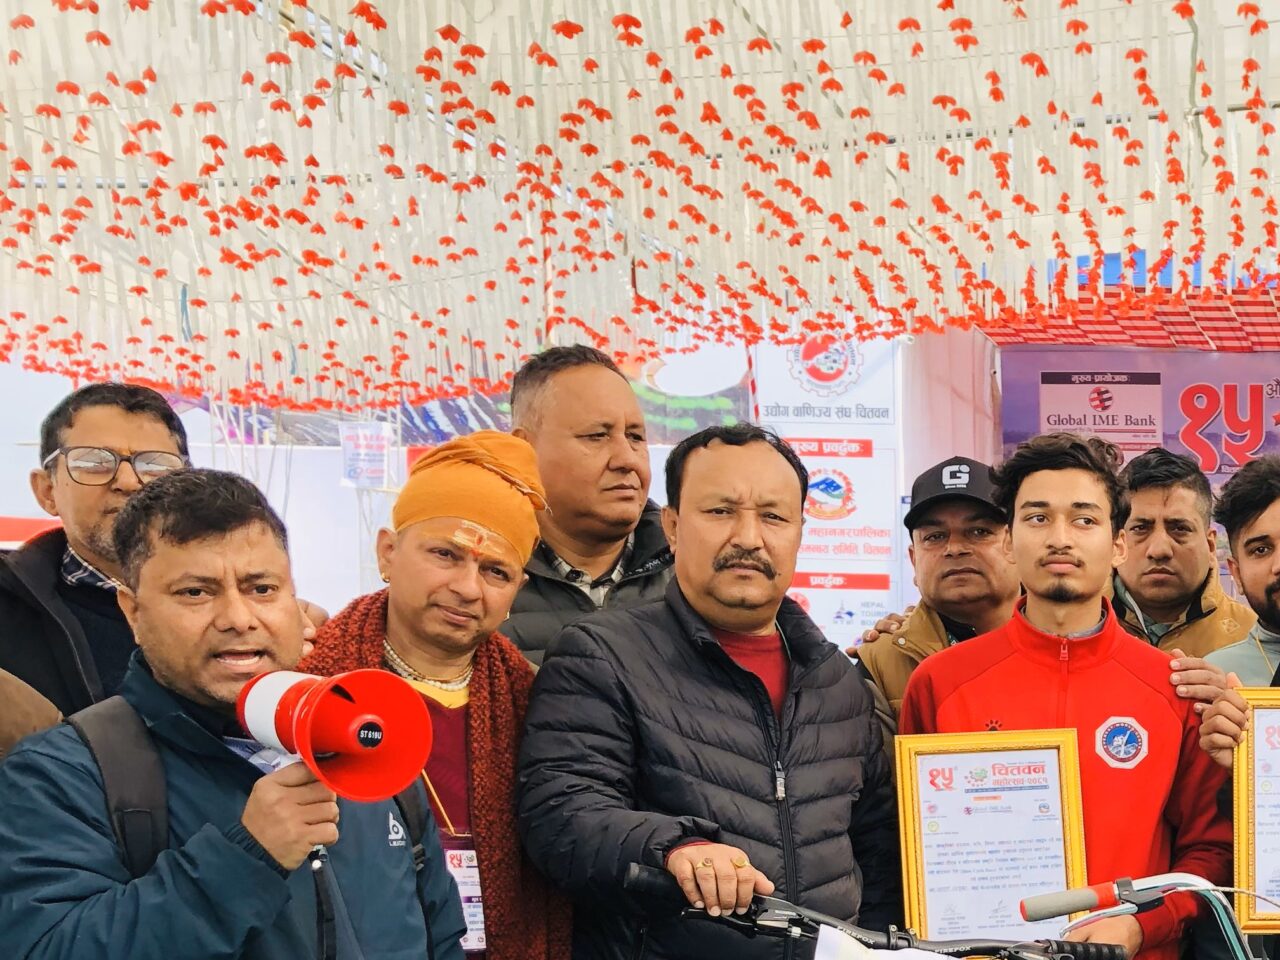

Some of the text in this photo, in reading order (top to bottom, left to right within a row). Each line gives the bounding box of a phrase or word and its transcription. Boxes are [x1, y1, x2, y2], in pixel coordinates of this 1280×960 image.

[763, 402, 889, 419] उद्योग वाणिज्य संघ चितवन
[1046, 414, 1157, 426] Global IME Bank
[1179, 383, 1266, 474] १५
[991, 763, 1046, 776] चितवन
